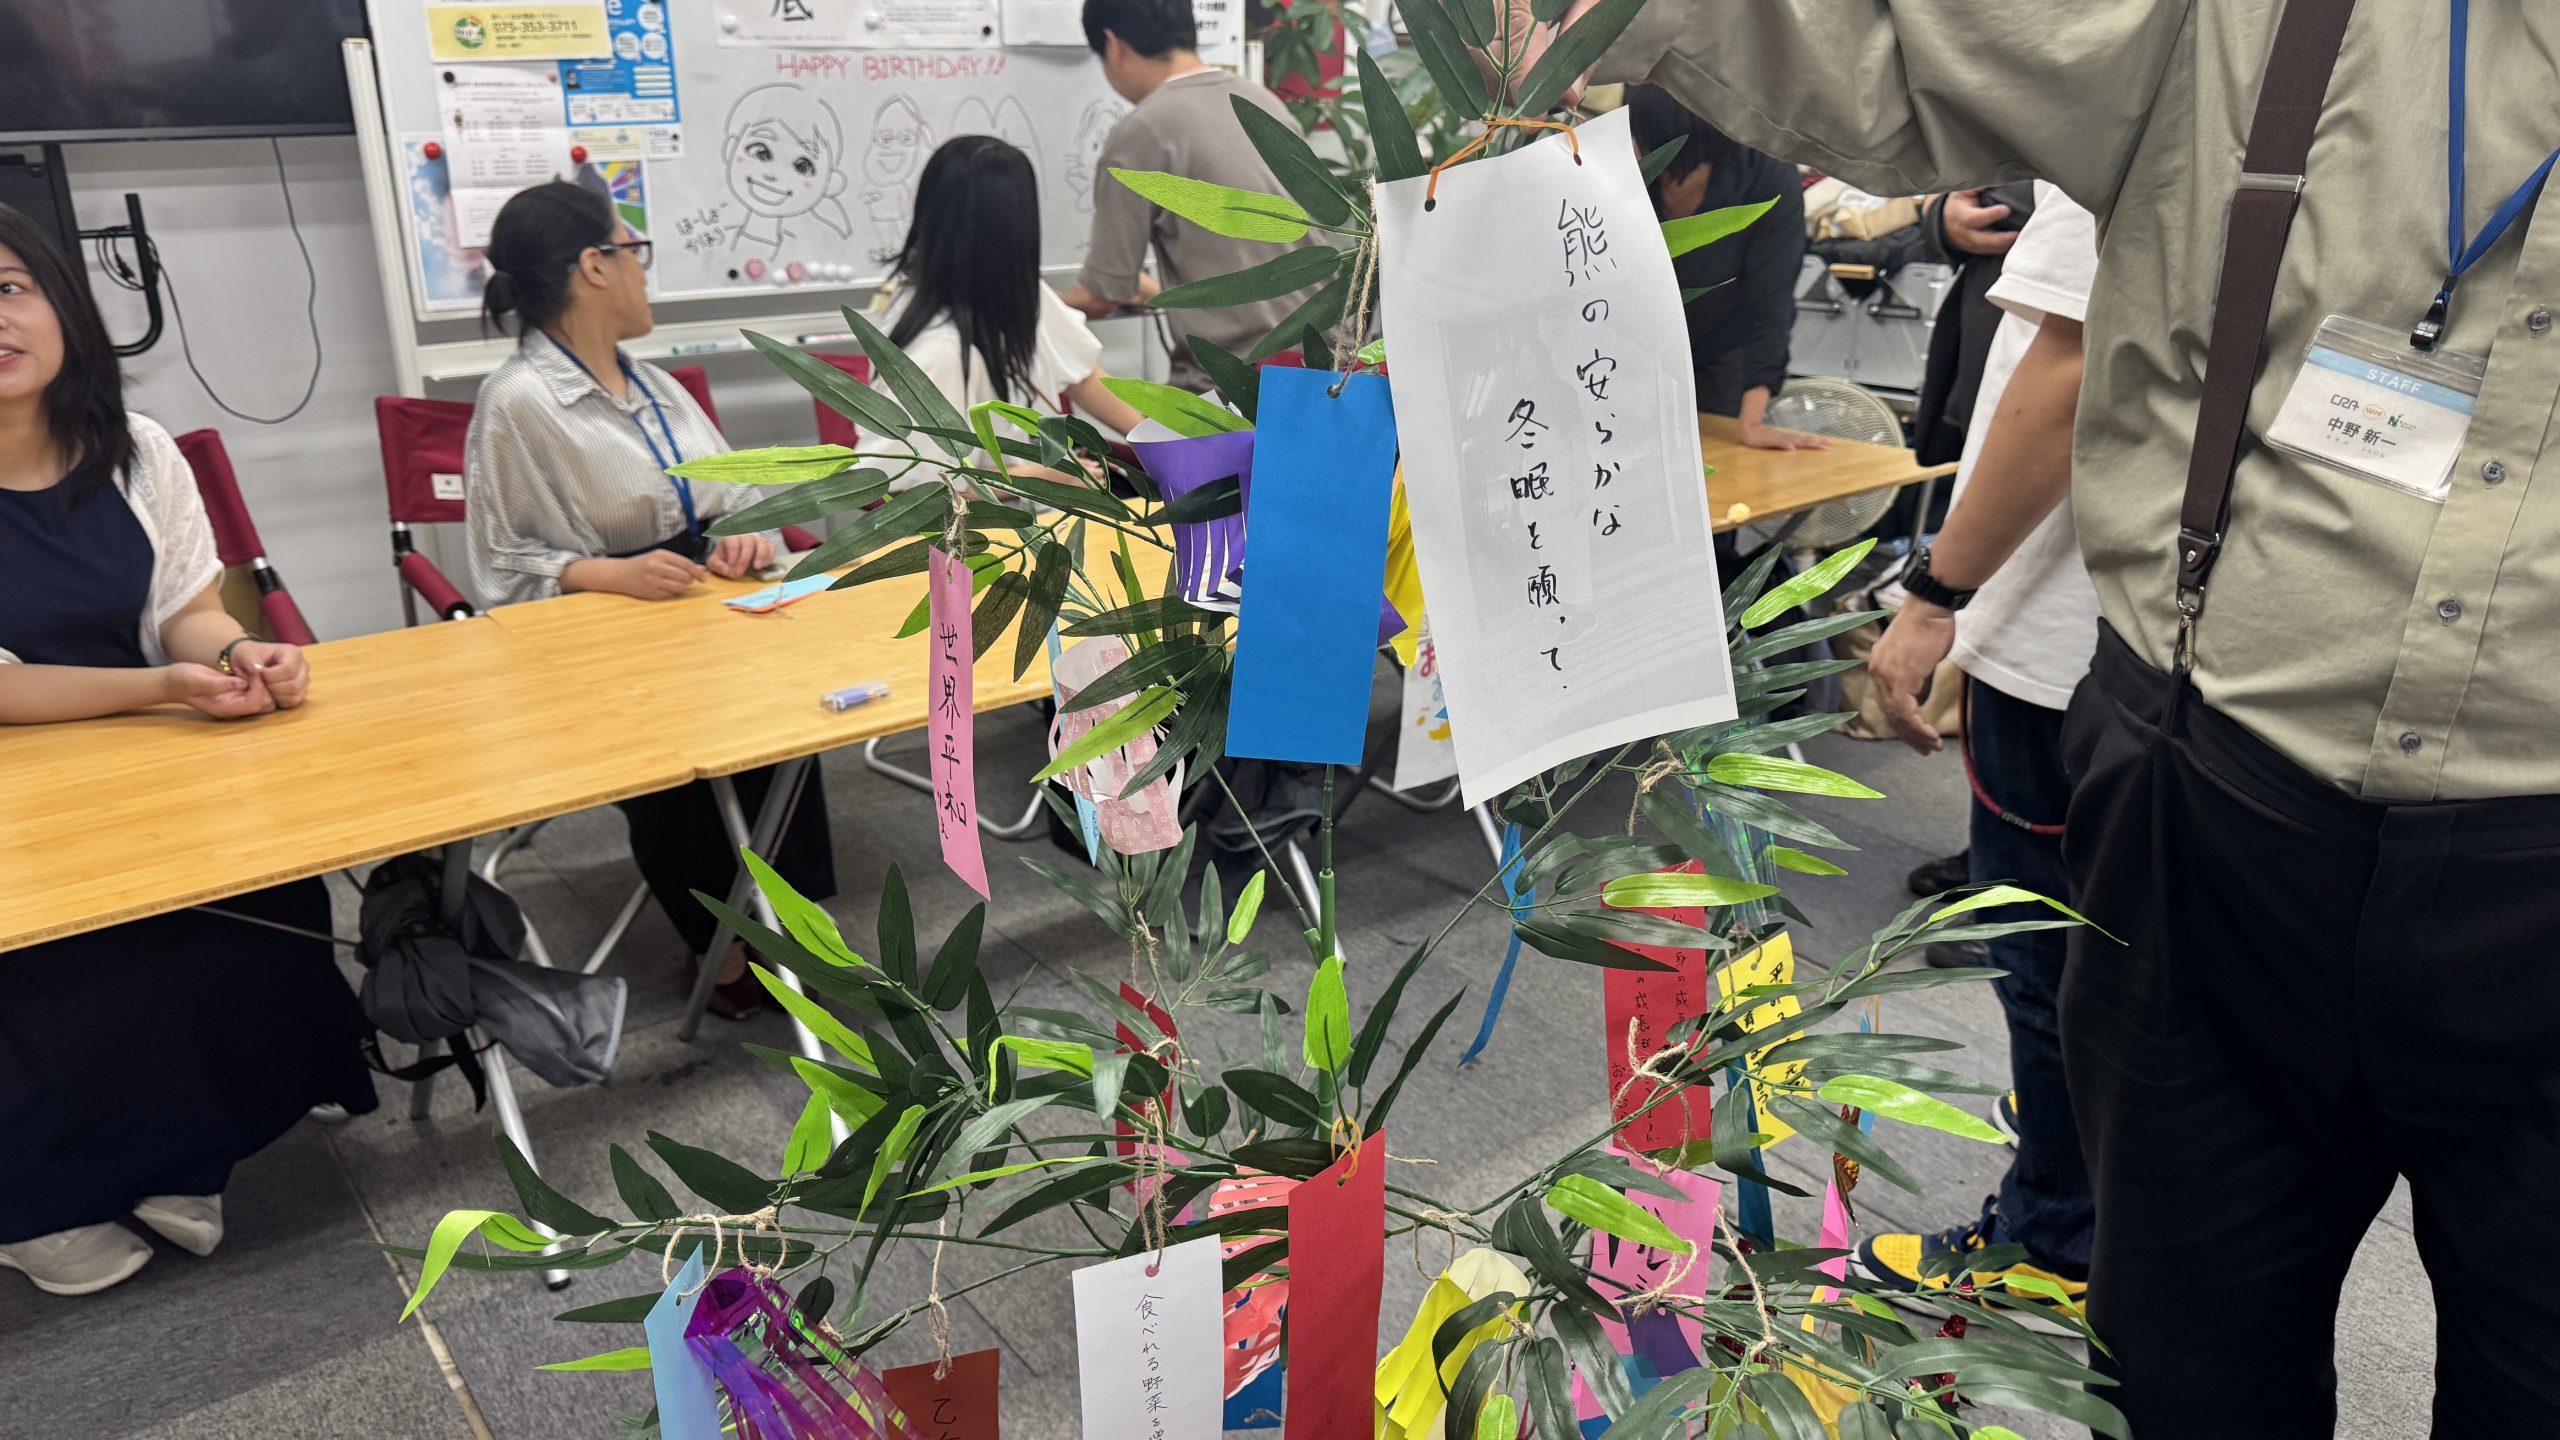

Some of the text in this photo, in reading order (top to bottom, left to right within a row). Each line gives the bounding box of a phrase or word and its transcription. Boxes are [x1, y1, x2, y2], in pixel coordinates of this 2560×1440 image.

[775, 53, 850, 79] HAPPY
[1557, 198, 1622, 536] 熊の安らかな
[2366, 368, 2423, 394] STAFF
[2327, 417, 2362, 438] 中野
[2361, 428, 2397, 446] 新一
[938, 622, 967, 827] 世界平和
